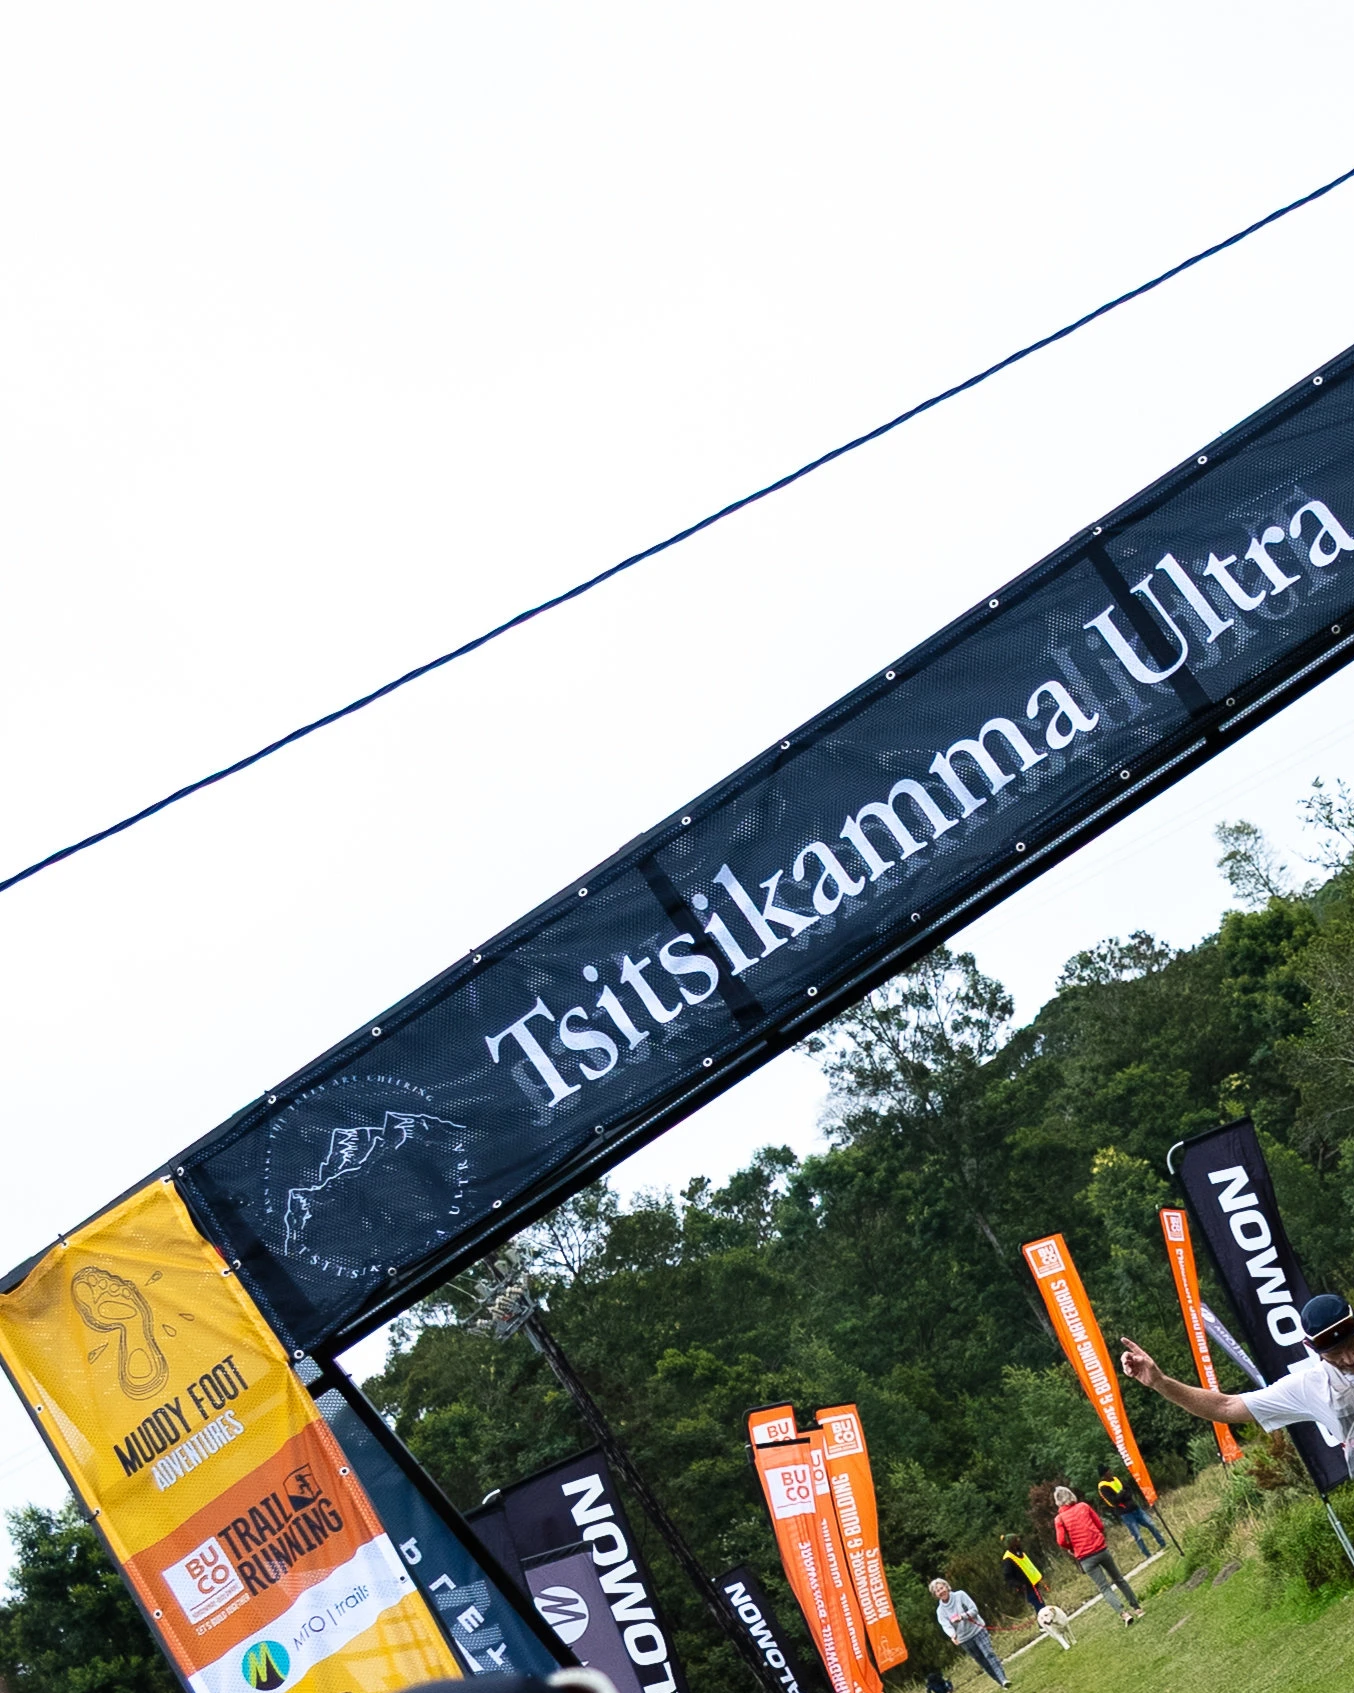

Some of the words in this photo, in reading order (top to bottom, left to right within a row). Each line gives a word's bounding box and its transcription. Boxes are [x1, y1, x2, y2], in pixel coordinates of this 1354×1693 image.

[484, 680, 1100, 1109] Tsitsikamma
[1207, 1165, 1346, 1447] LOMON
[112, 1396, 192, 1477] MUDDY
[186, 1354, 249, 1420] FOOT
[151, 1409, 245, 1492] ADVENTURES
[217, 1492, 293, 1561] TRAIL
[237, 1496, 344, 1597] RUNNING
[831, 1472, 862, 1538] BUILDING
[335, 1583, 370, 1616] trails
